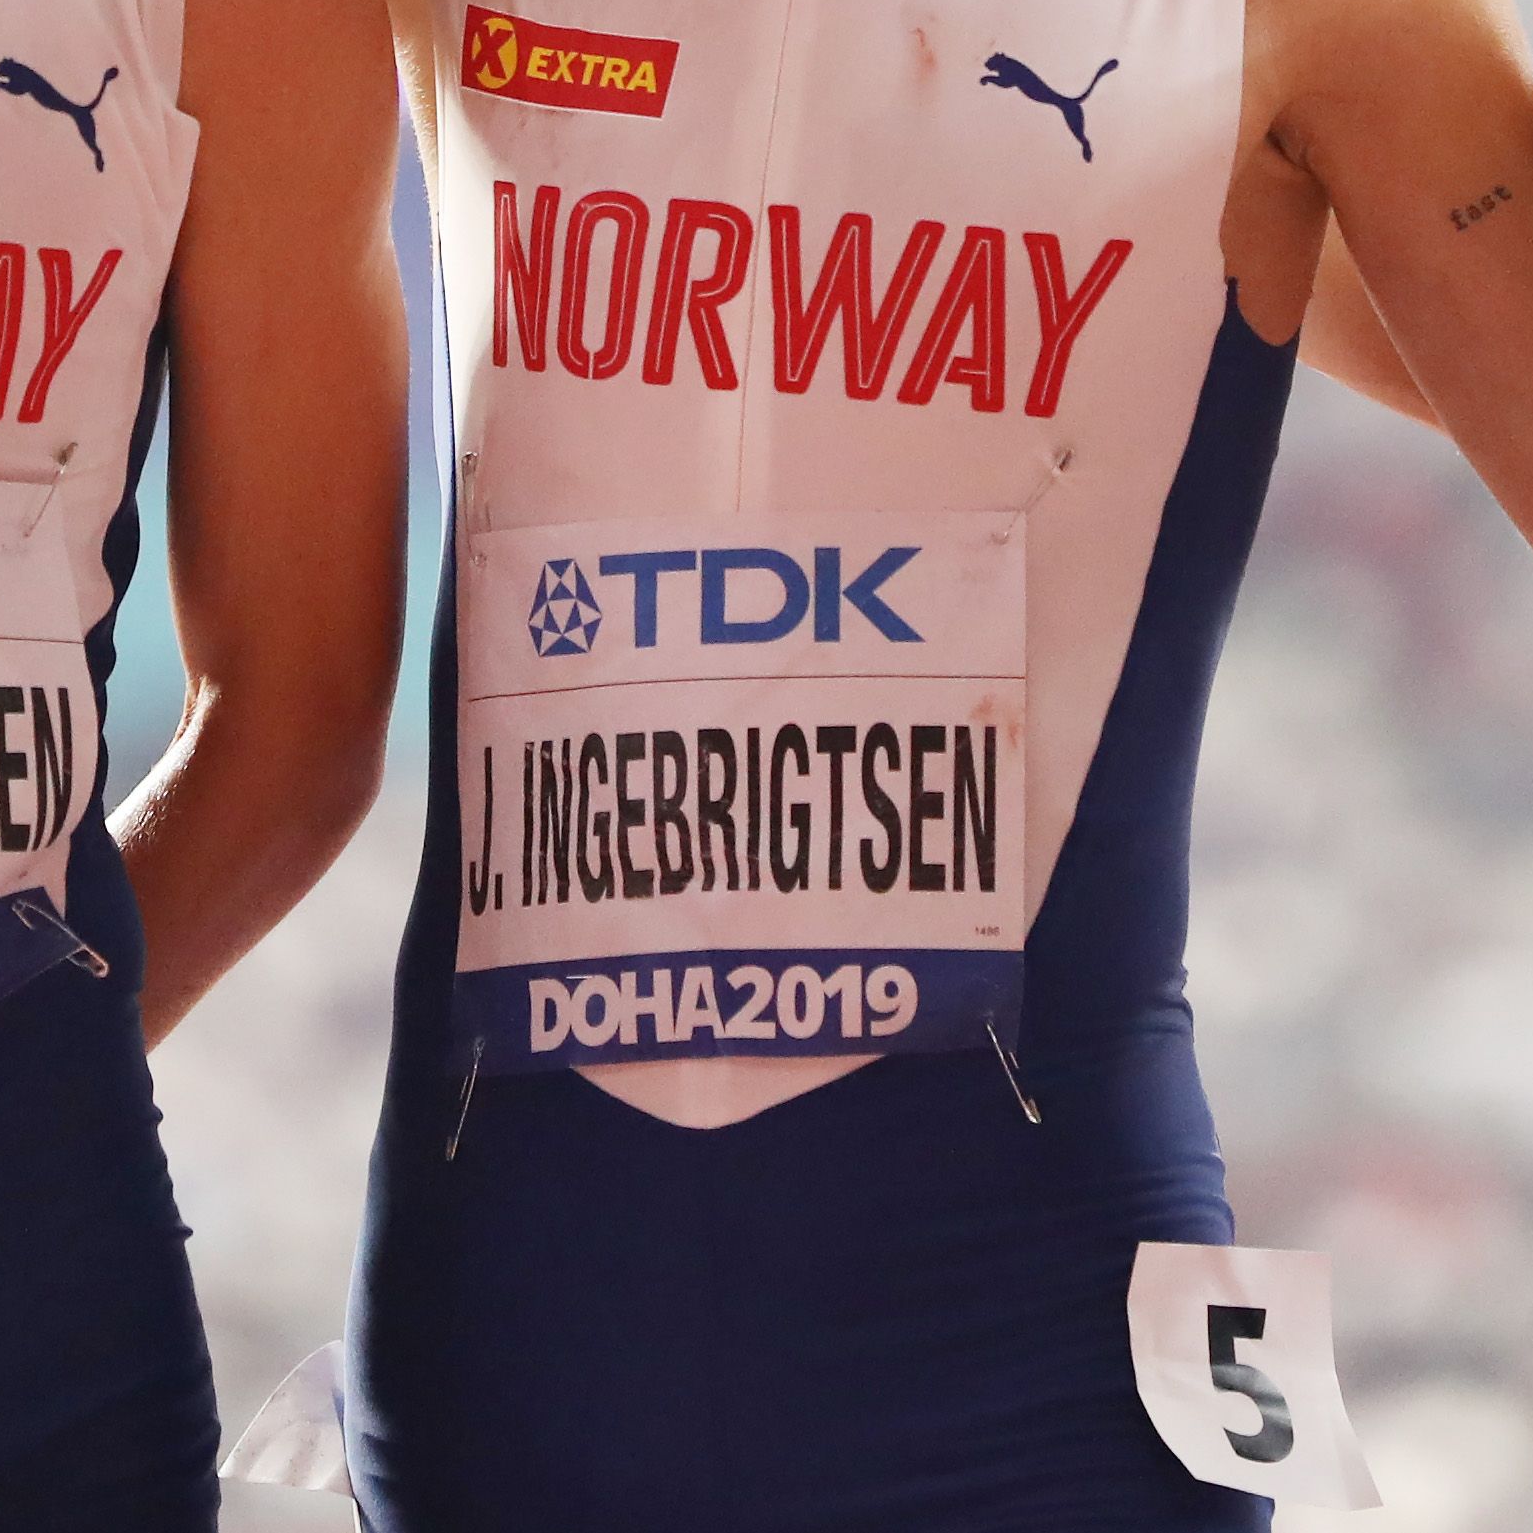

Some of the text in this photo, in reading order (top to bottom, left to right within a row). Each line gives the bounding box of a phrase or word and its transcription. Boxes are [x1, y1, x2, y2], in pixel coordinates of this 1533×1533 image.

[526, 46, 657, 94] EXTRA
[493, 181, 1135, 420] NORWAY
[598, 546, 925, 649] TDK
[468, 722, 998, 916] J. INGEBRIGTSEN
[528, 964, 919, 1053] DOHA2019
[1206, 1303, 1294, 1464] 5
